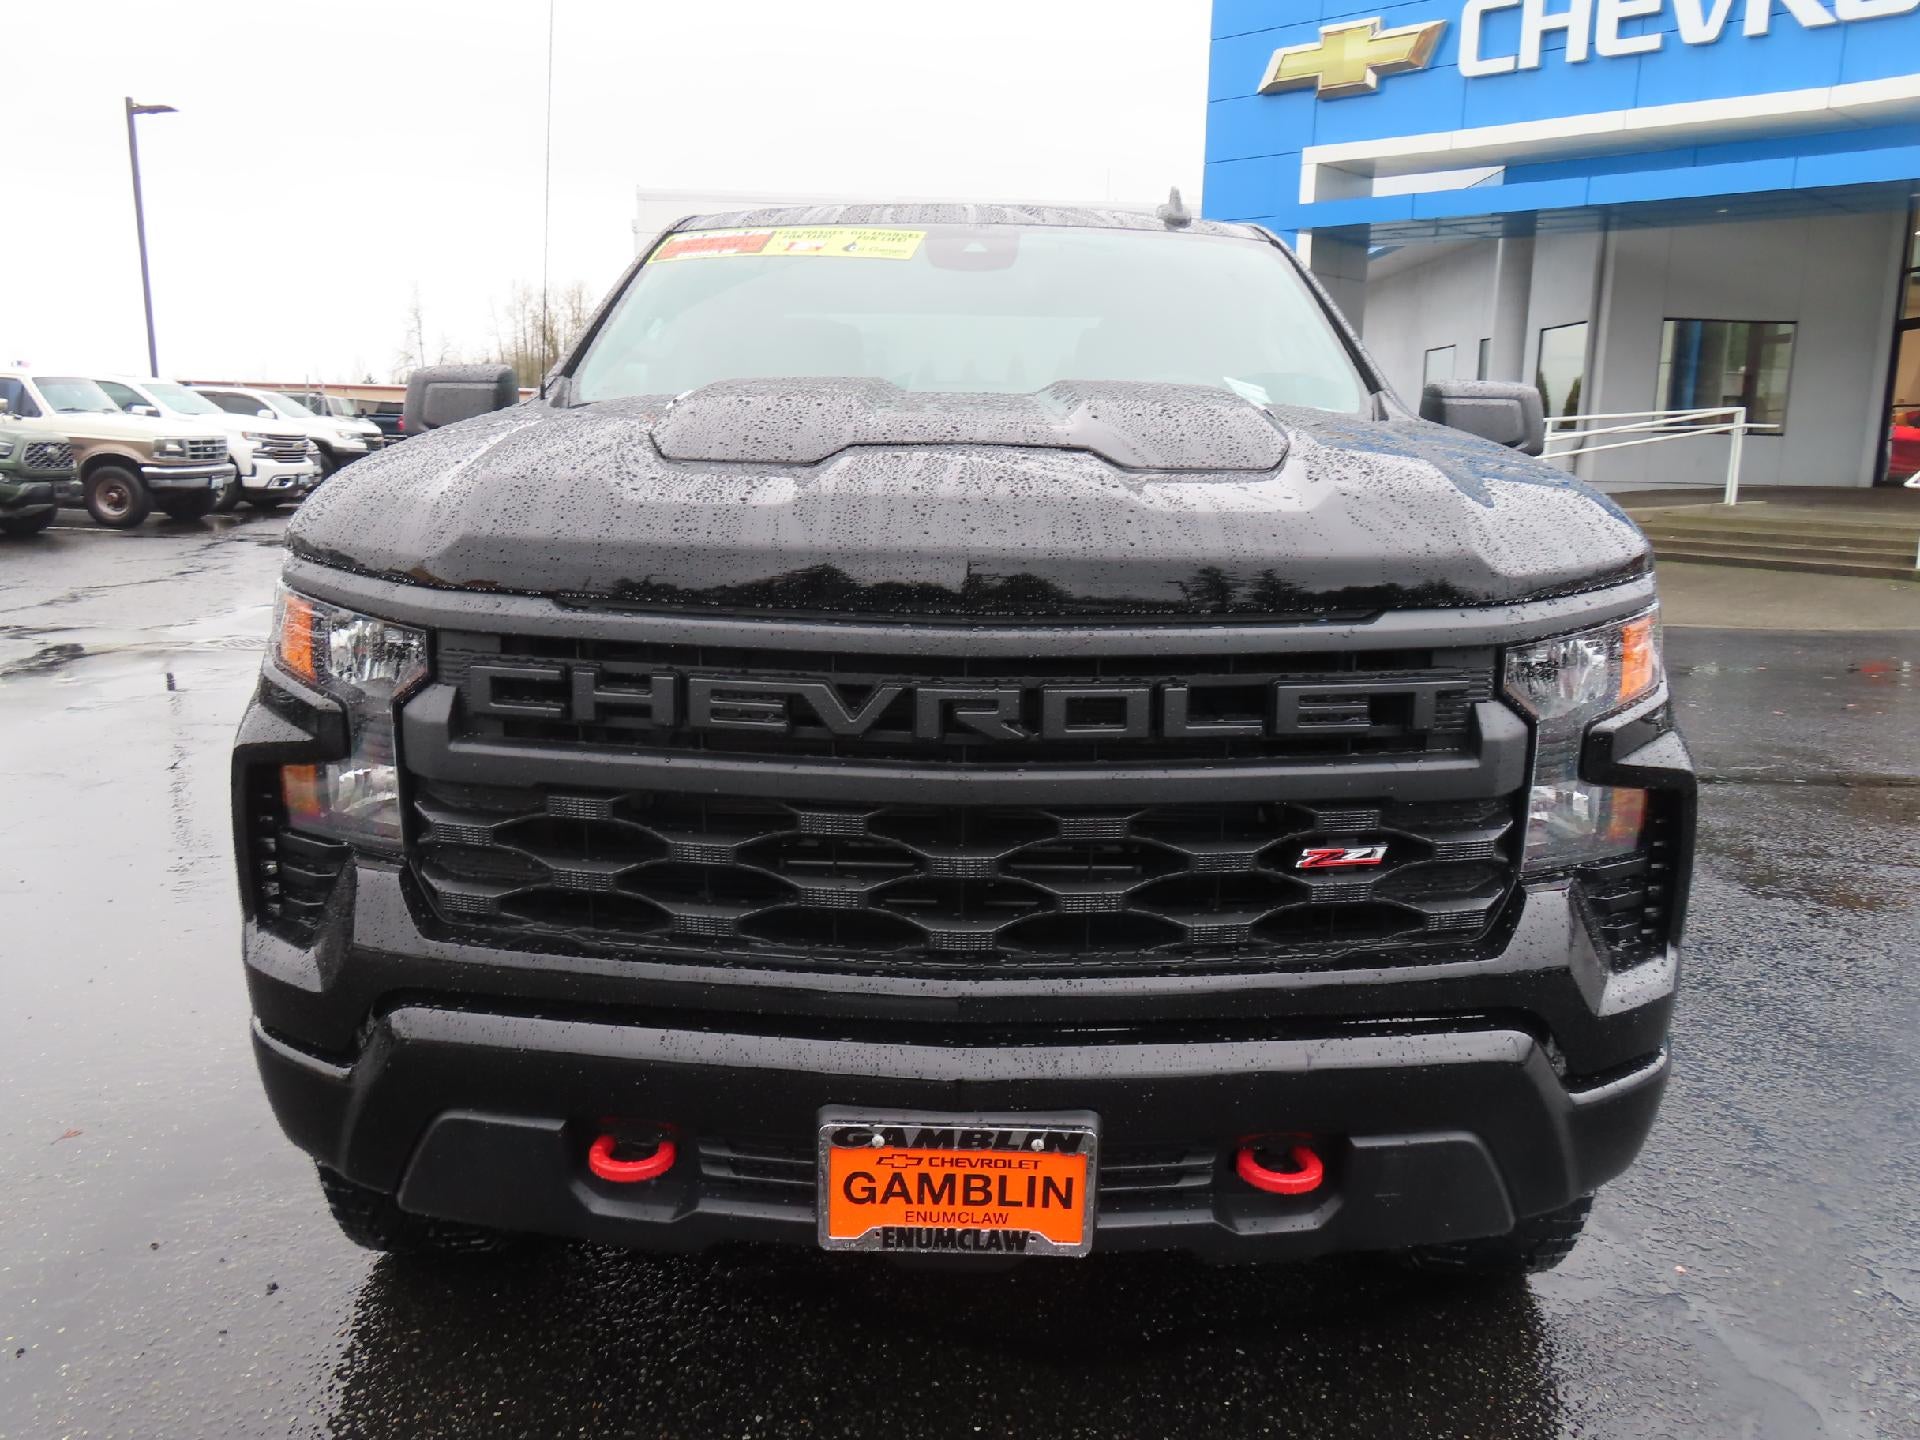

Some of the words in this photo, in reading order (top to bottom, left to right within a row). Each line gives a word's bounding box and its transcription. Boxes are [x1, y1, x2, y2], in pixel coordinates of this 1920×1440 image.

[1458, 0, 1920, 78] CHEV
[467, 662, 1471, 740] CHEVROLET
[1295, 845, 1389, 869] Z71
[831, 1126, 1085, 1154] GAMBLIN
[928, 1156, 1043, 1170] CHEVROLET
[842, 1170, 1075, 1210] GAMBLIN
[904, 1210, 1010, 1225] ENUMCLAW
[881, 1226, 1030, 1251] ENUMCLAW
